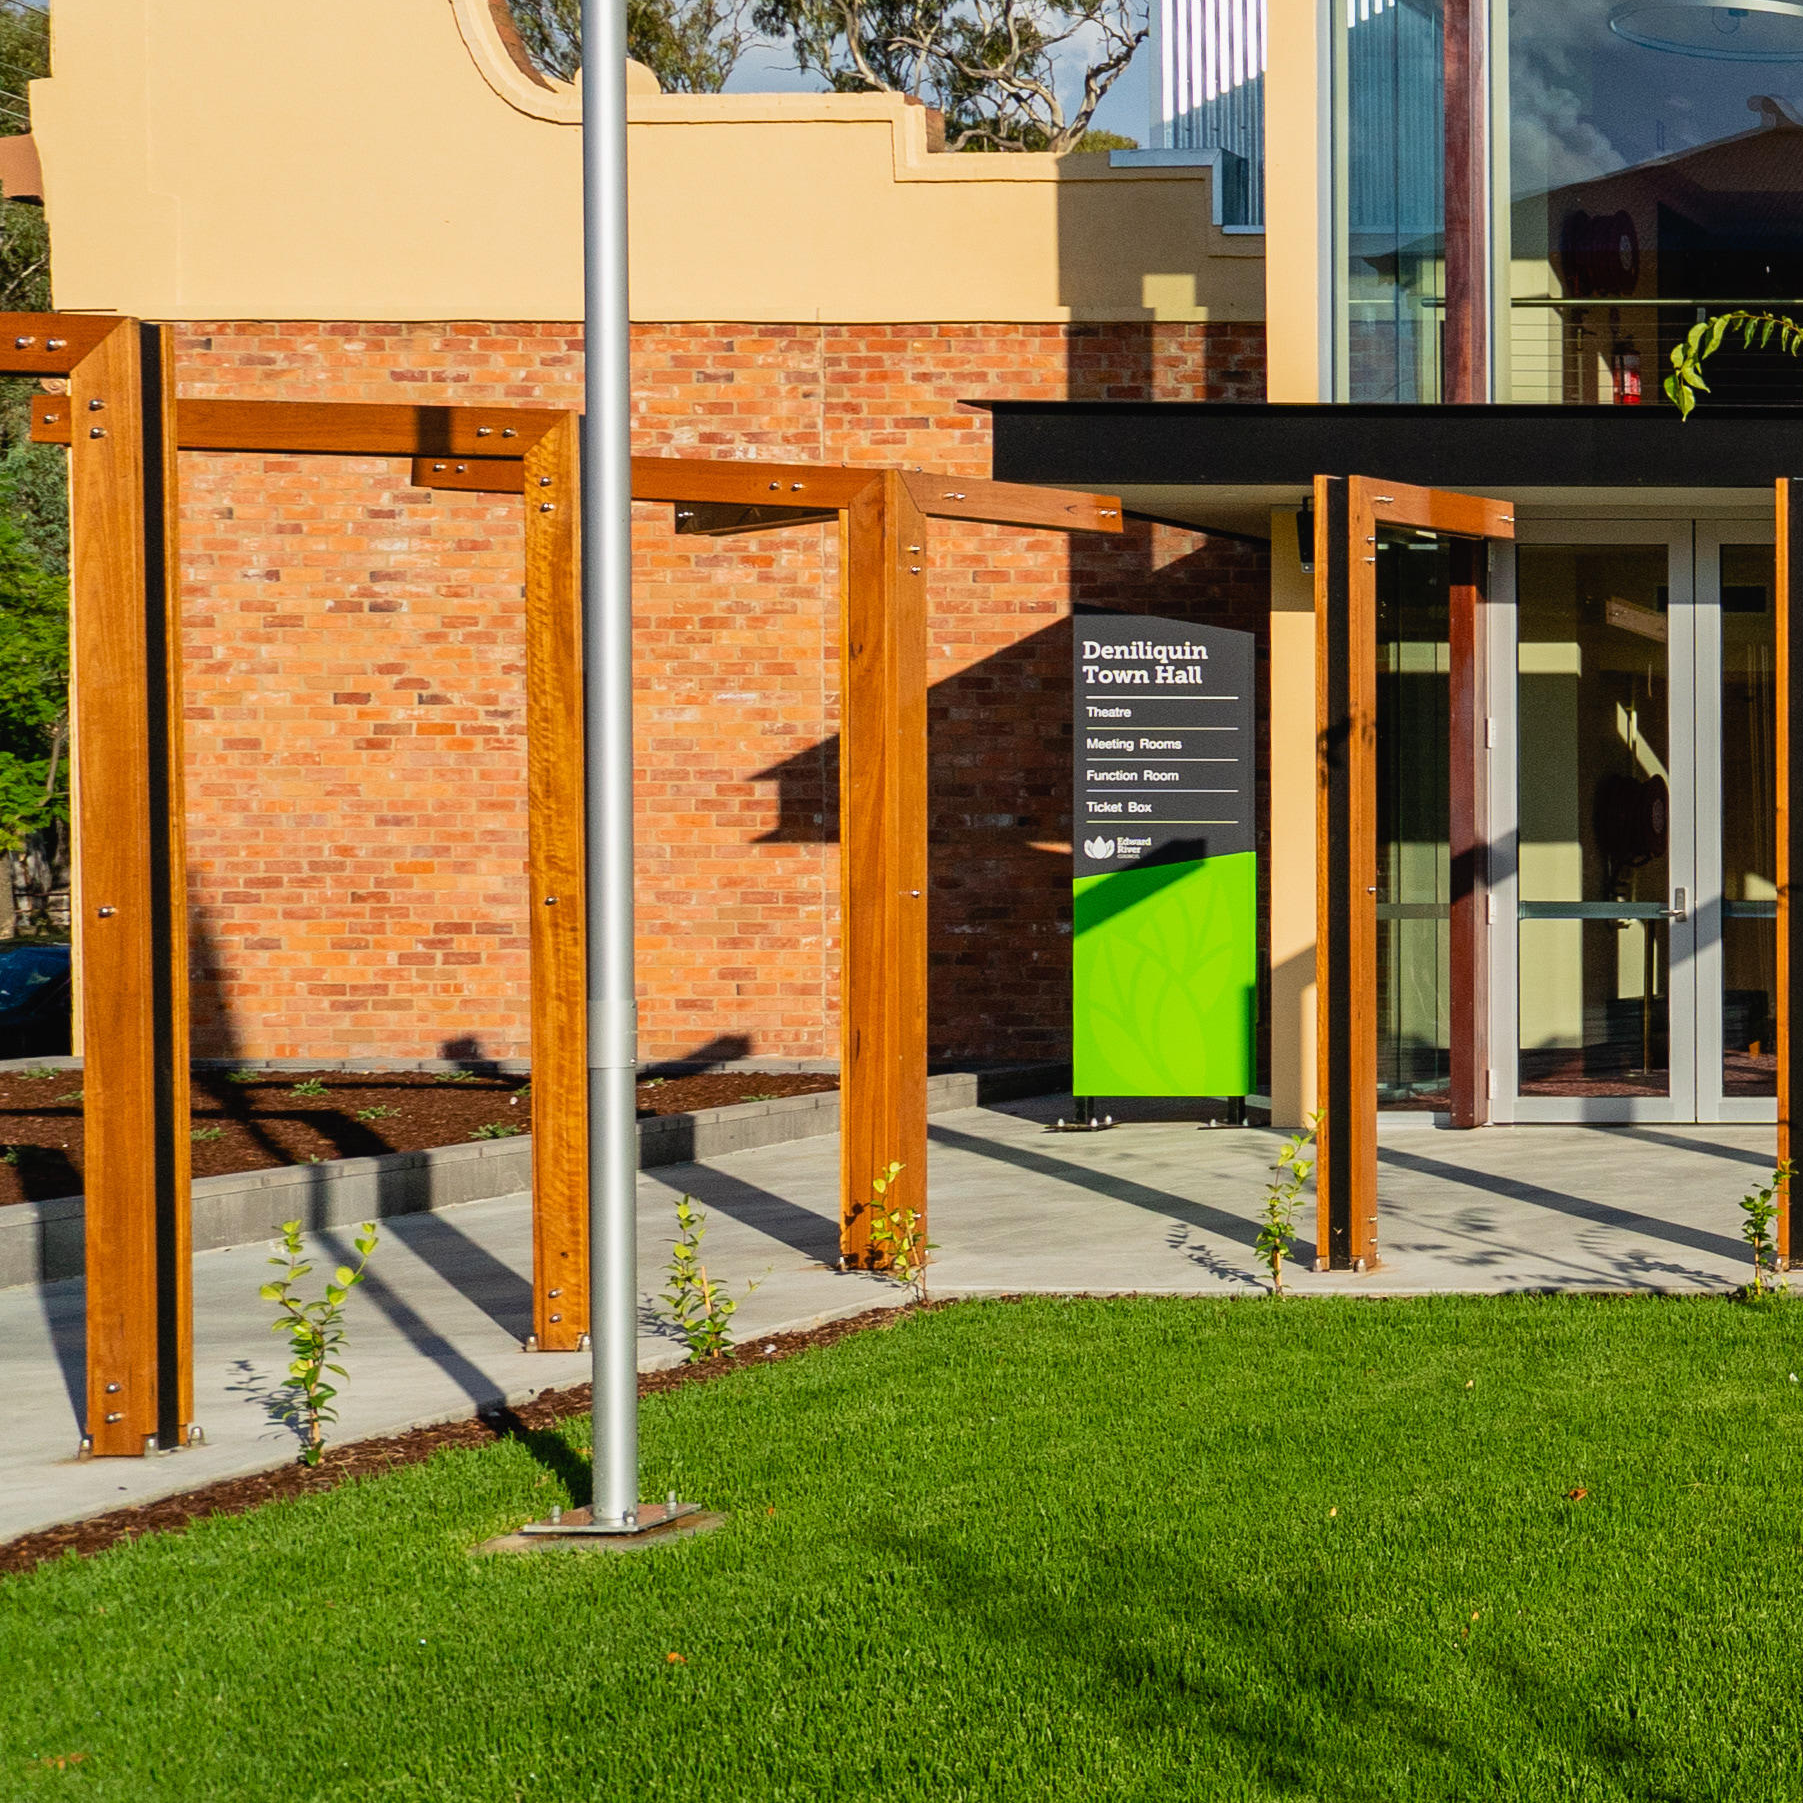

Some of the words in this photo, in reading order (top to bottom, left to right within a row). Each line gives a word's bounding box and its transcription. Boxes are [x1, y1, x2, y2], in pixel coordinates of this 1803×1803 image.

[1082, 640, 1208, 664] Deniliquin
[1082, 665, 1150, 684] Town
[1155, 665, 1203, 684] Hall
[1086, 706, 1132, 718] Theatre
[1086, 737, 1135, 752] Meeting
[1139, 737, 1183, 750] Rooms
[1086, 769, 1138, 782] Function
[1143, 769, 1180, 782] Room
[1086, 801, 1123, 813] Ticket
[1128, 801, 1153, 813] Box
[1116, 836, 1152, 846] Edward
[1116, 845, 1141, 854] River
